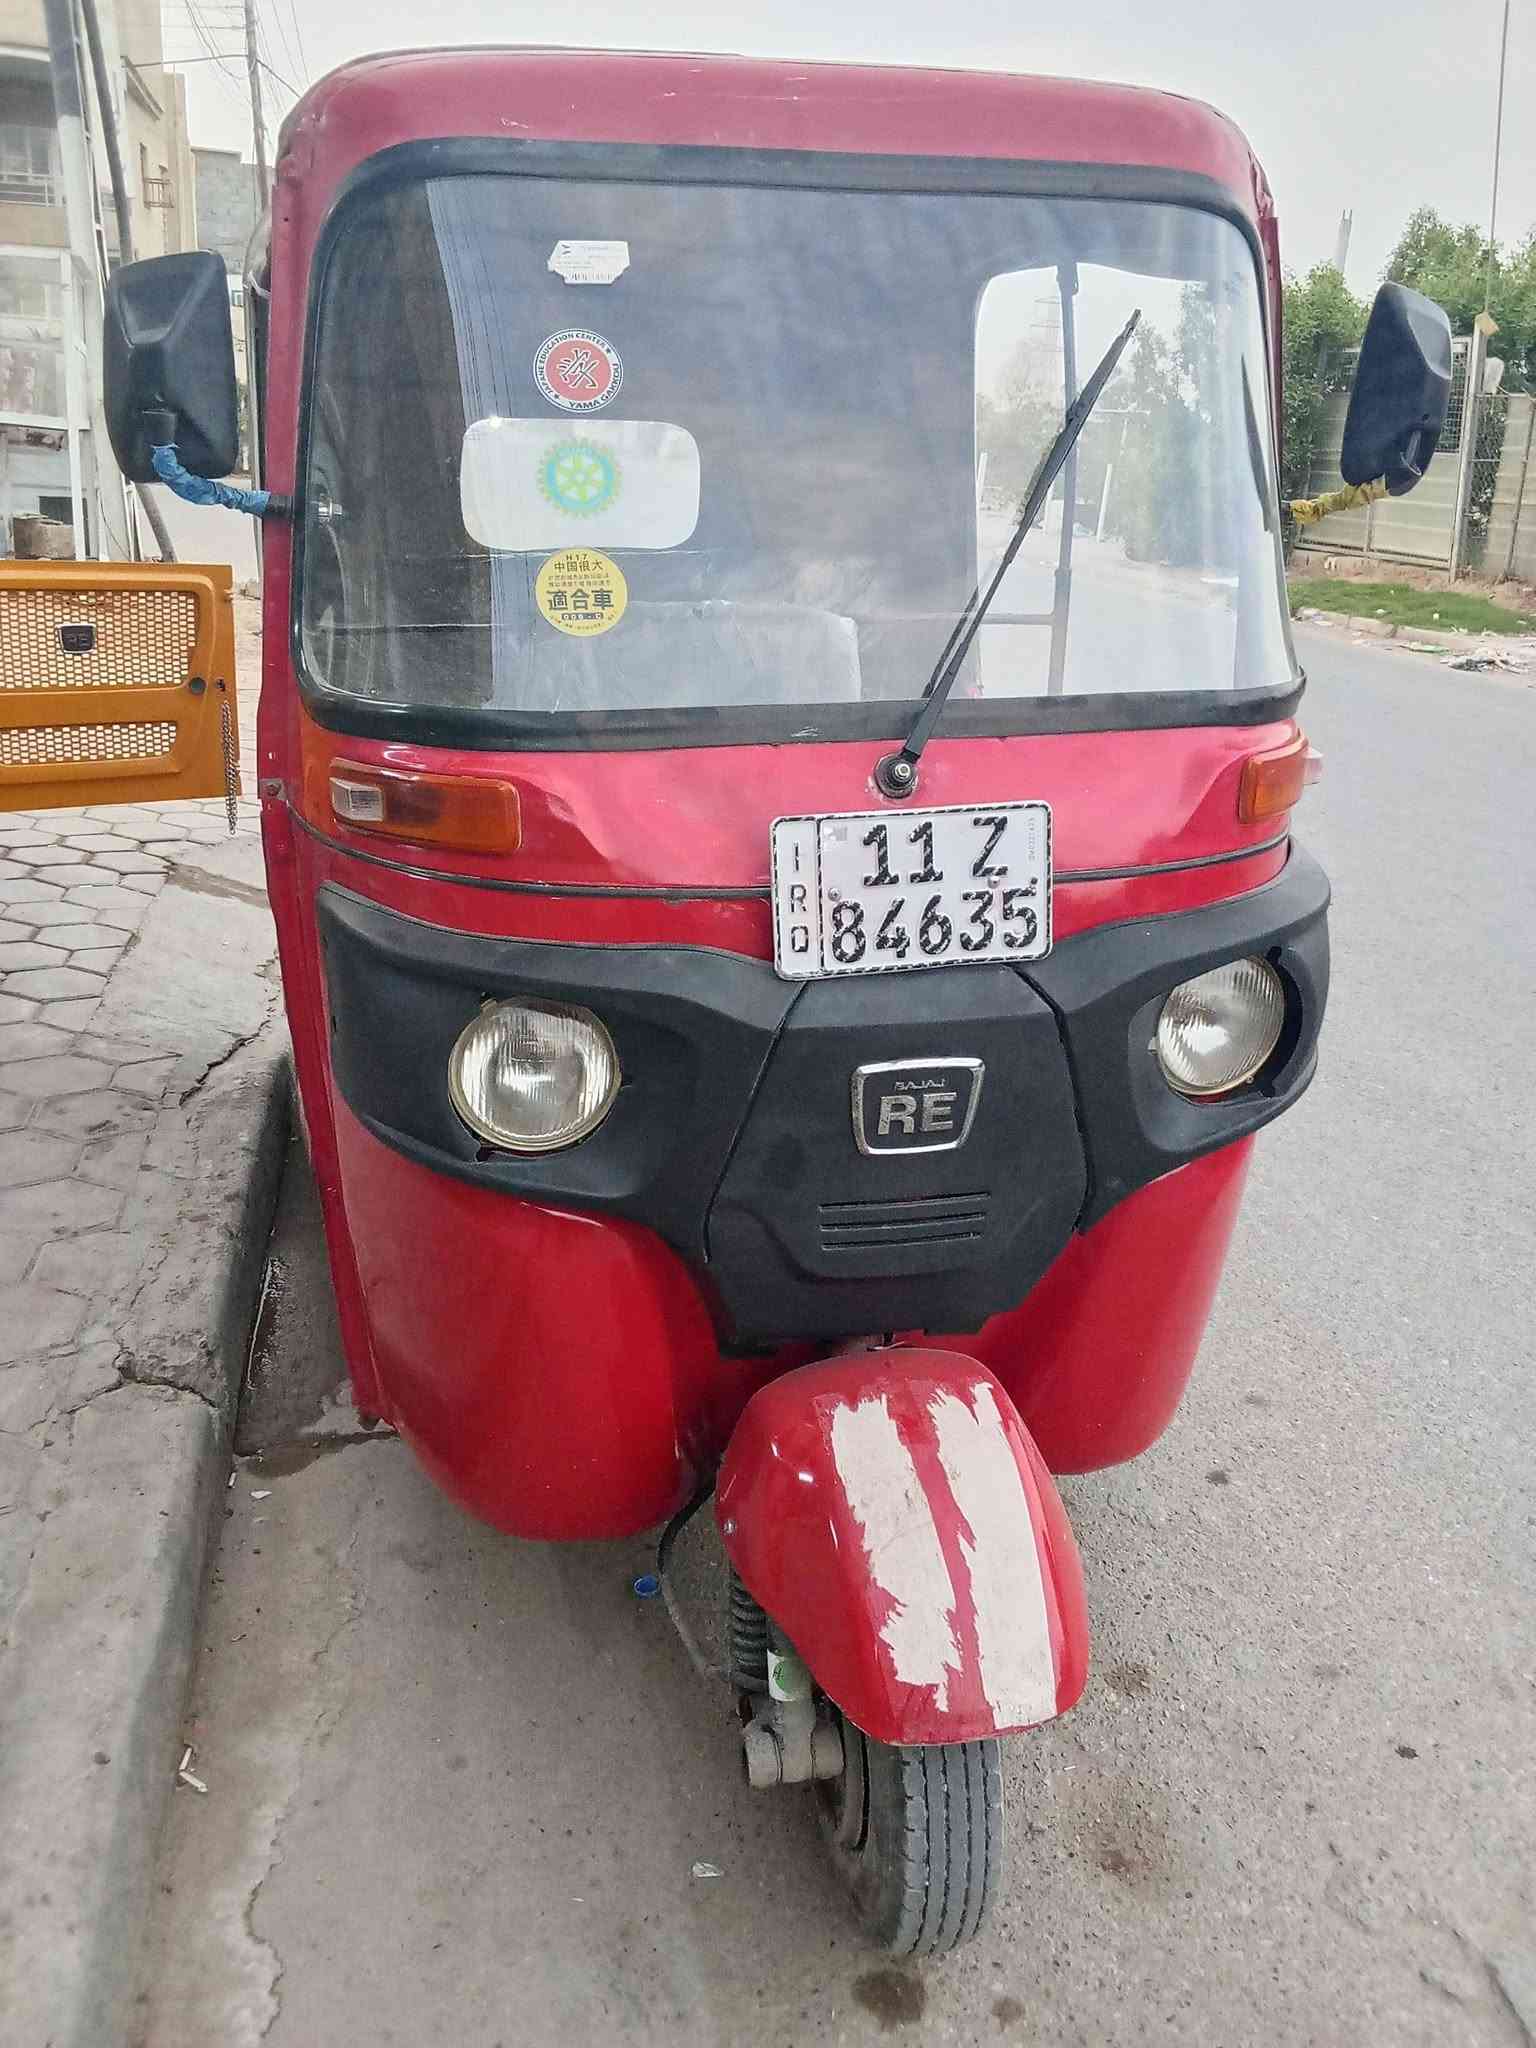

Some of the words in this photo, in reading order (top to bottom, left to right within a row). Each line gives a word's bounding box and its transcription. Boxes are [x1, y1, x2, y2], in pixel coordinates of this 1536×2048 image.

[539, 332, 574, 363] EDUCATION
[569, 400, 600, 409] YAMA
[546, 588, 614, 610] 適合車
[863, 821, 944, 886] 11
[972, 816, 1009, 877] Z
[831, 887, 1038, 964] 84635
[877, 1092, 958, 1135] RE
